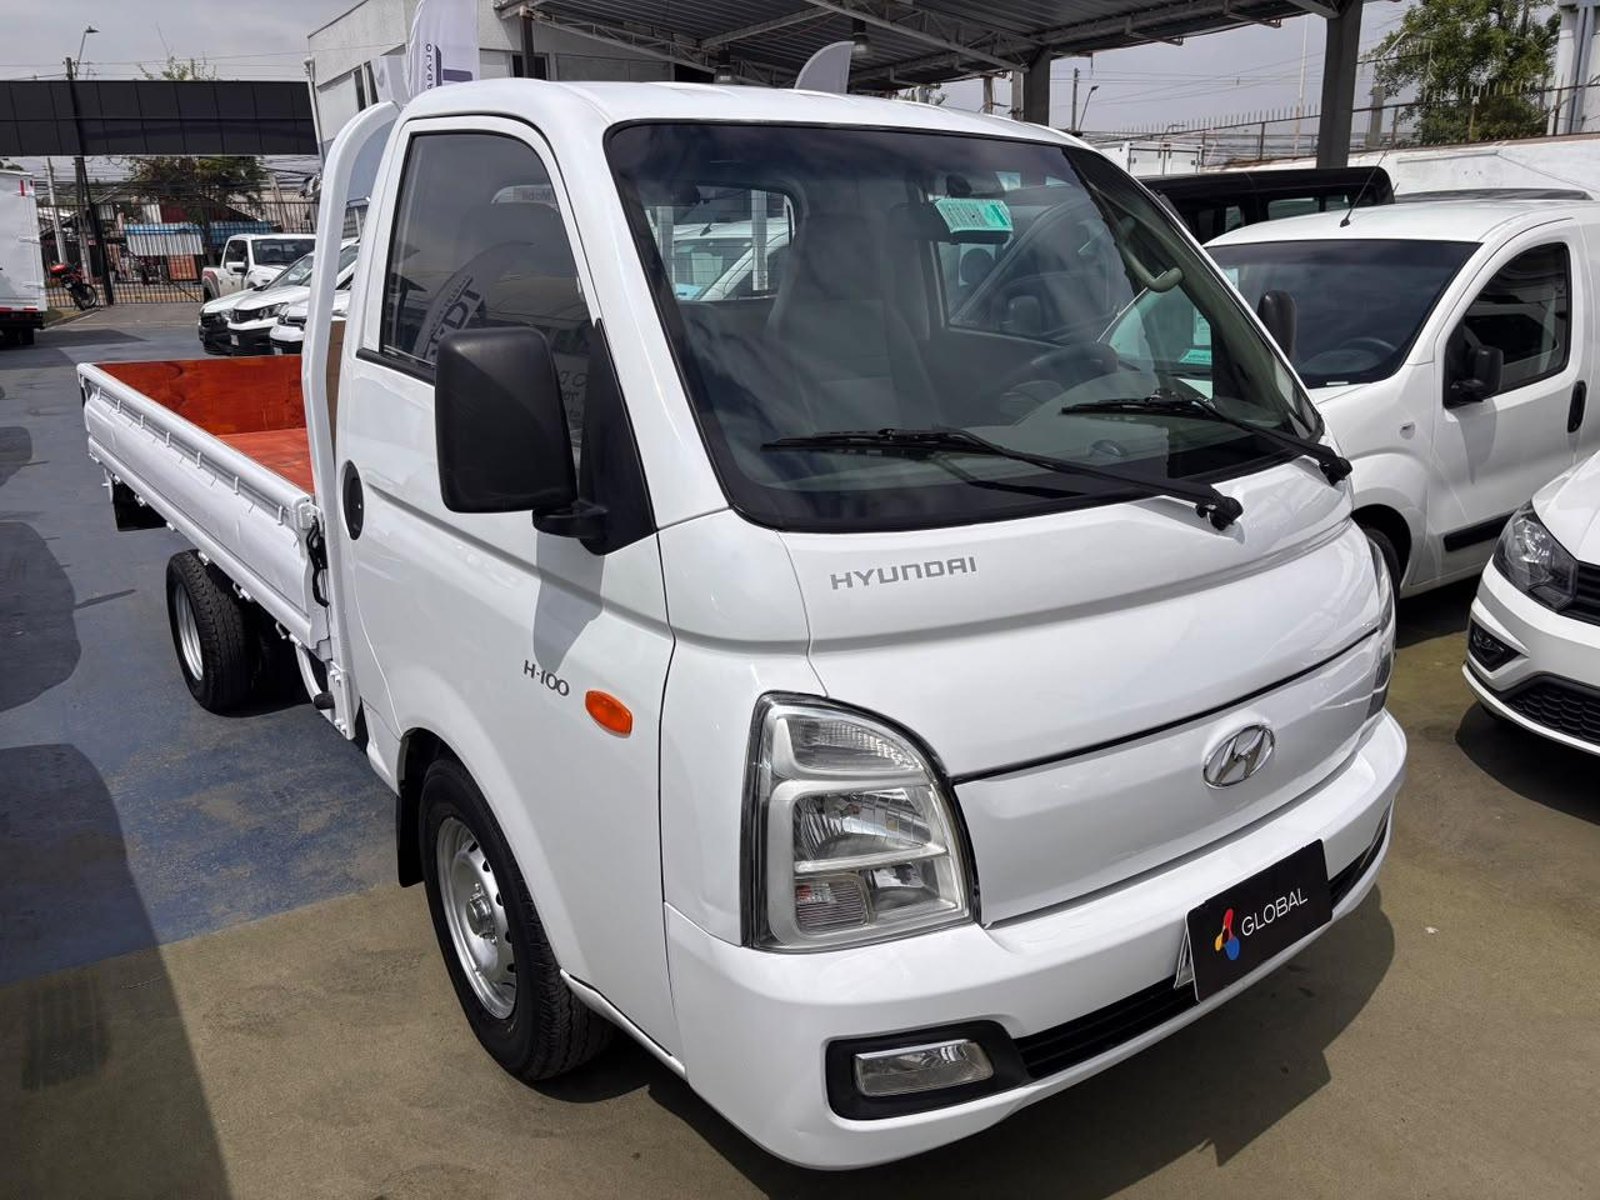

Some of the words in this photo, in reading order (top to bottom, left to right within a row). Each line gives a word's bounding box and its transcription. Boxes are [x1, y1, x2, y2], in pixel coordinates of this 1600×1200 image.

[830, 556, 977, 590] HYUNDAI
[523, 659, 570, 697] H-100
[1241, 887, 1309, 936] GLOBAL
